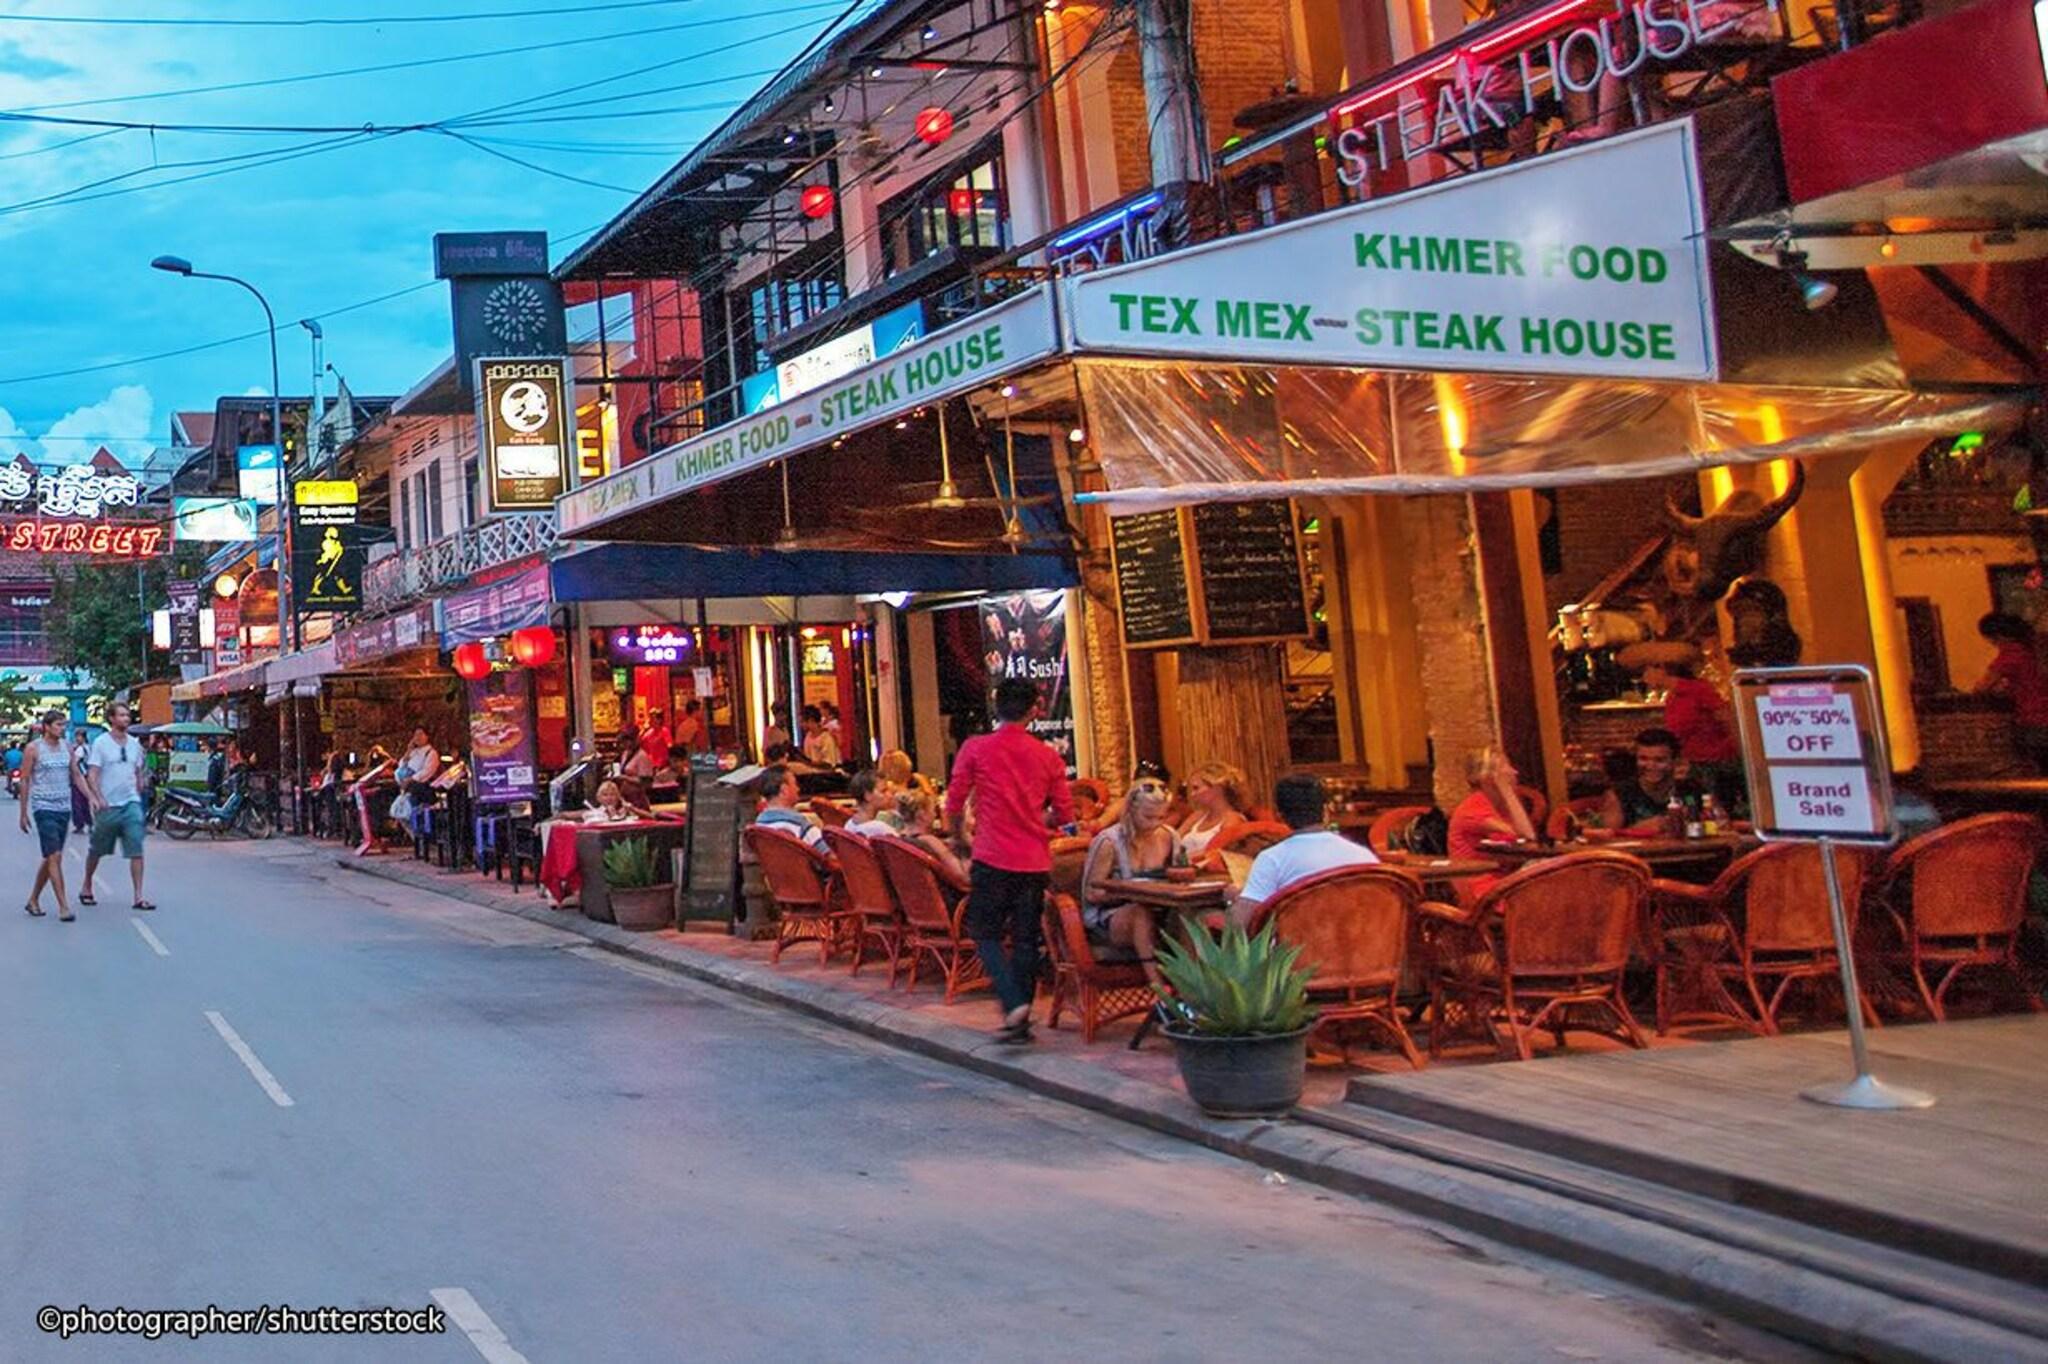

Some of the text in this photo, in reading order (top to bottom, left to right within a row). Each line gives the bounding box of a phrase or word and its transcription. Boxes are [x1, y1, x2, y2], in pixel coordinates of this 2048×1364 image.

[1337, 0, 1737, 187] STEAK HOUSE
[1354, 233, 1668, 283] KHMER FOOD
[1110, 294, 1676, 360] TEX MEX STEAK HOUSE
[674, 437, 734, 482] KHMER
[738, 414, 790, 458] FOOD
[820, 368, 898, 427] STEAK
[905, 325, 1004, 396] HOUSE
[11, 522, 162, 556] STREET
[1029, 656, 1065, 679] Sushi
[1787, 735, 1834, 752] OFF
[1788, 782, 1851, 798] Brand
[1799, 801, 1845, 816] Sale
